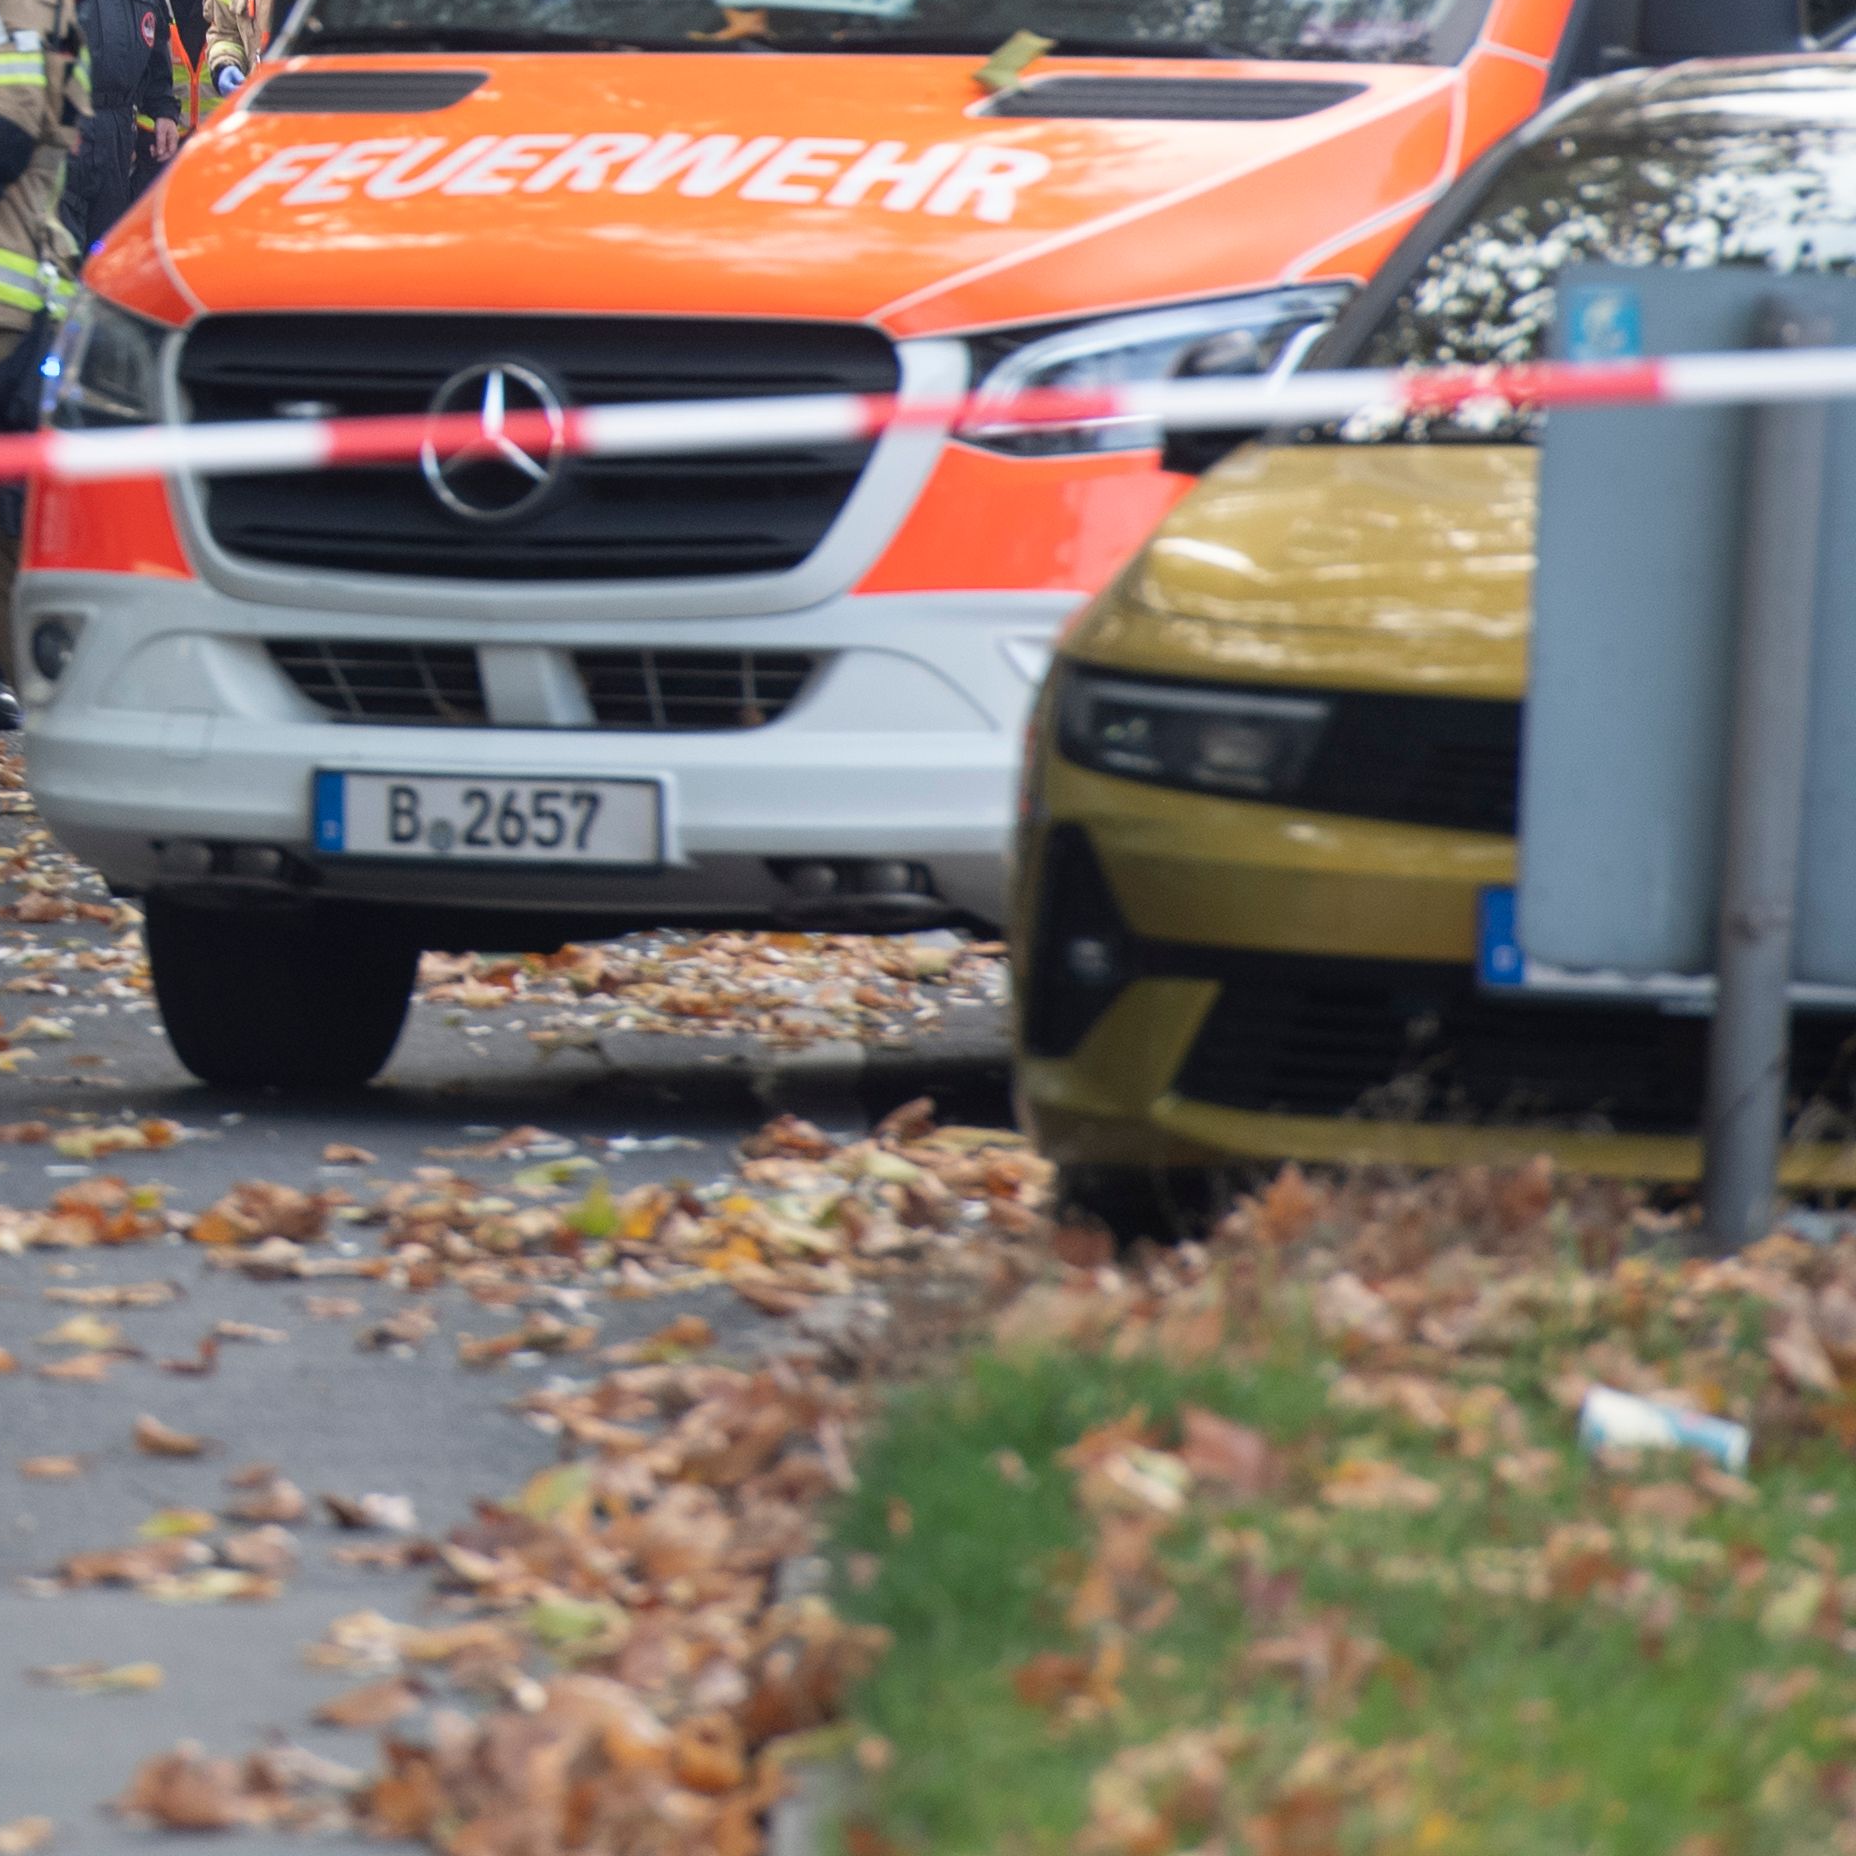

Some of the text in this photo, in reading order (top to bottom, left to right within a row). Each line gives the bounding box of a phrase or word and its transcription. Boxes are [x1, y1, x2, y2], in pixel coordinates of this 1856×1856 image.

[209, 130, 1053, 224] FEUERWEHR
[388, 785, 422, 844] B
[462, 787, 602, 851] 2657
